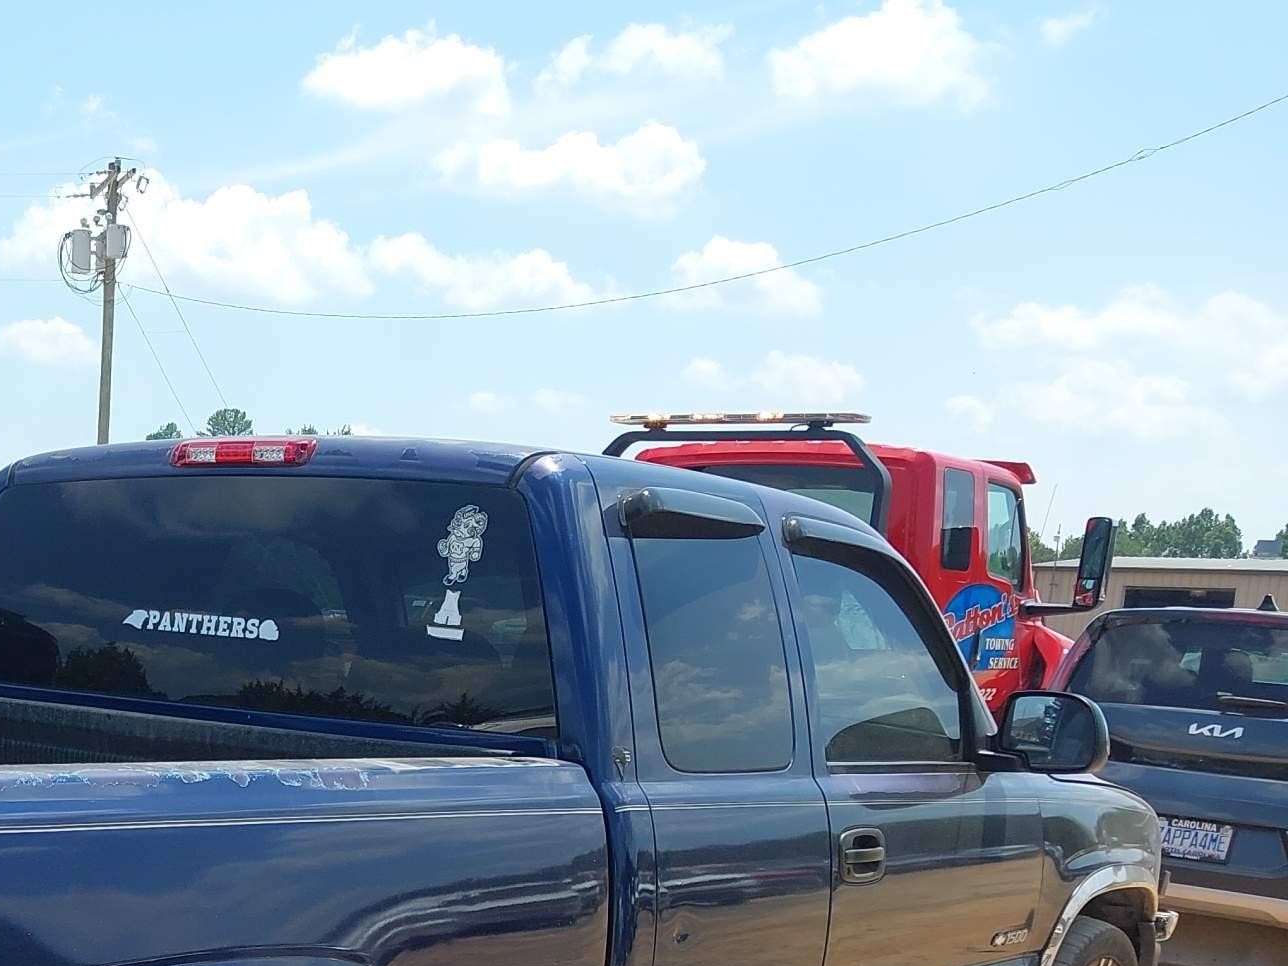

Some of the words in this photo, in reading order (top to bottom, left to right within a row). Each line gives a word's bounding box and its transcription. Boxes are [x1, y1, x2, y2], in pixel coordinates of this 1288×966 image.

[147, 610, 260, 639] PANTHERS
[985, 639, 1015, 651] TOWING
[988, 657, 1019, 669] SERVICE
[1172, 819, 1217, 832] CAROLINA
